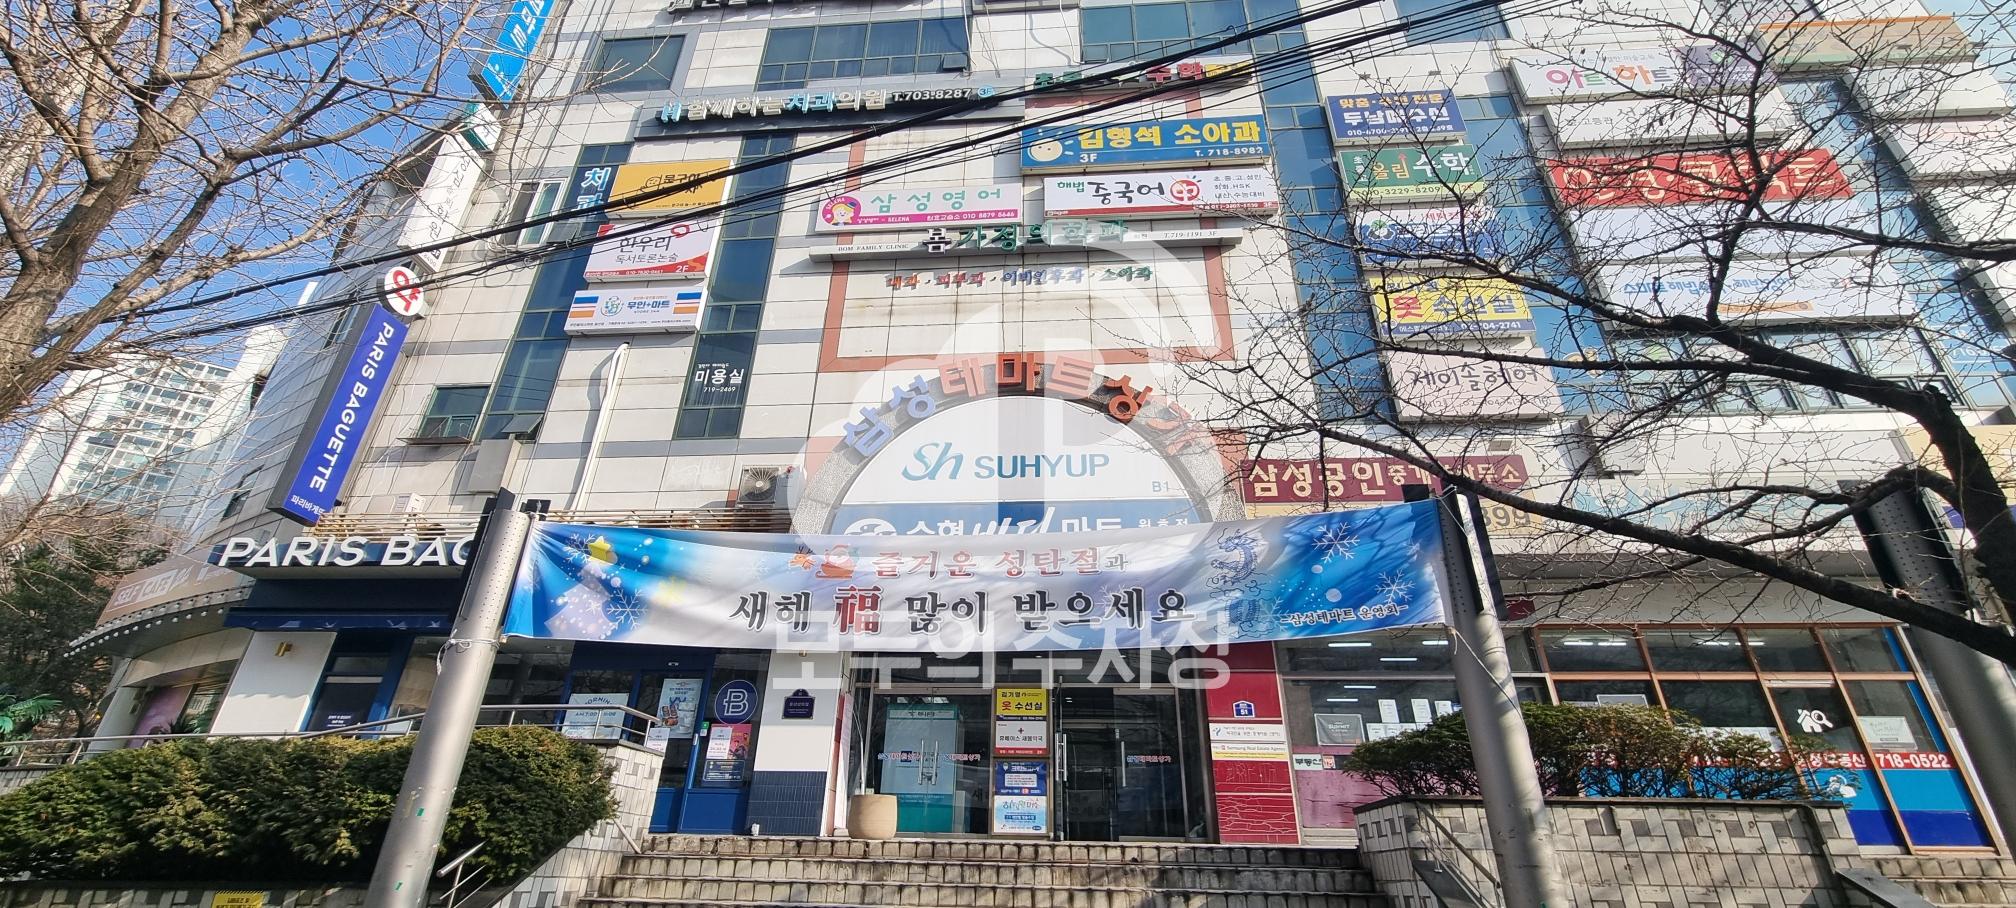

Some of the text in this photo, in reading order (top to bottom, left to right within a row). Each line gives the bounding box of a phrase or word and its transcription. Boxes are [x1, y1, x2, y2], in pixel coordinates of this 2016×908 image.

[1077, 120, 1261, 150] 김형석 소아과
[1079, 152, 1098, 163] 3F
[1207, 146, 1264, 157] 718-8982
[1413, 152, 1470, 178] 수학
[870, 188, 1001, 214] 삼성영어
[1057, 181, 1085, 194] 해법
[1087, 180, 1166, 205] 중국어
[619, 235, 672, 253] 한우리
[615, 253, 679, 265] 독서토론논술
[676, 265, 689, 273] 2F
[885, 265, 1153, 290] 내과 피부과 이비인후과 소아과
[1393, 294, 1516, 319] 옷 수선실
[694, 368, 745, 385] 미용실
[308, 321, 395, 494] PARIS BAGUETTE
[901, 441, 1110, 482] Sh SUHYUP
[1151, 480, 1169, 493] B1
[218, 536, 373, 567] PARIS
[871, 546, 1129, 580] 즐거운 성탄절과
[728, 584, 1198, 636] 새해 福 많이 받으세요
[1001, 700, 1043, 711] 옷 수선실
[1876, 753, 1952, 769] 718-0522
